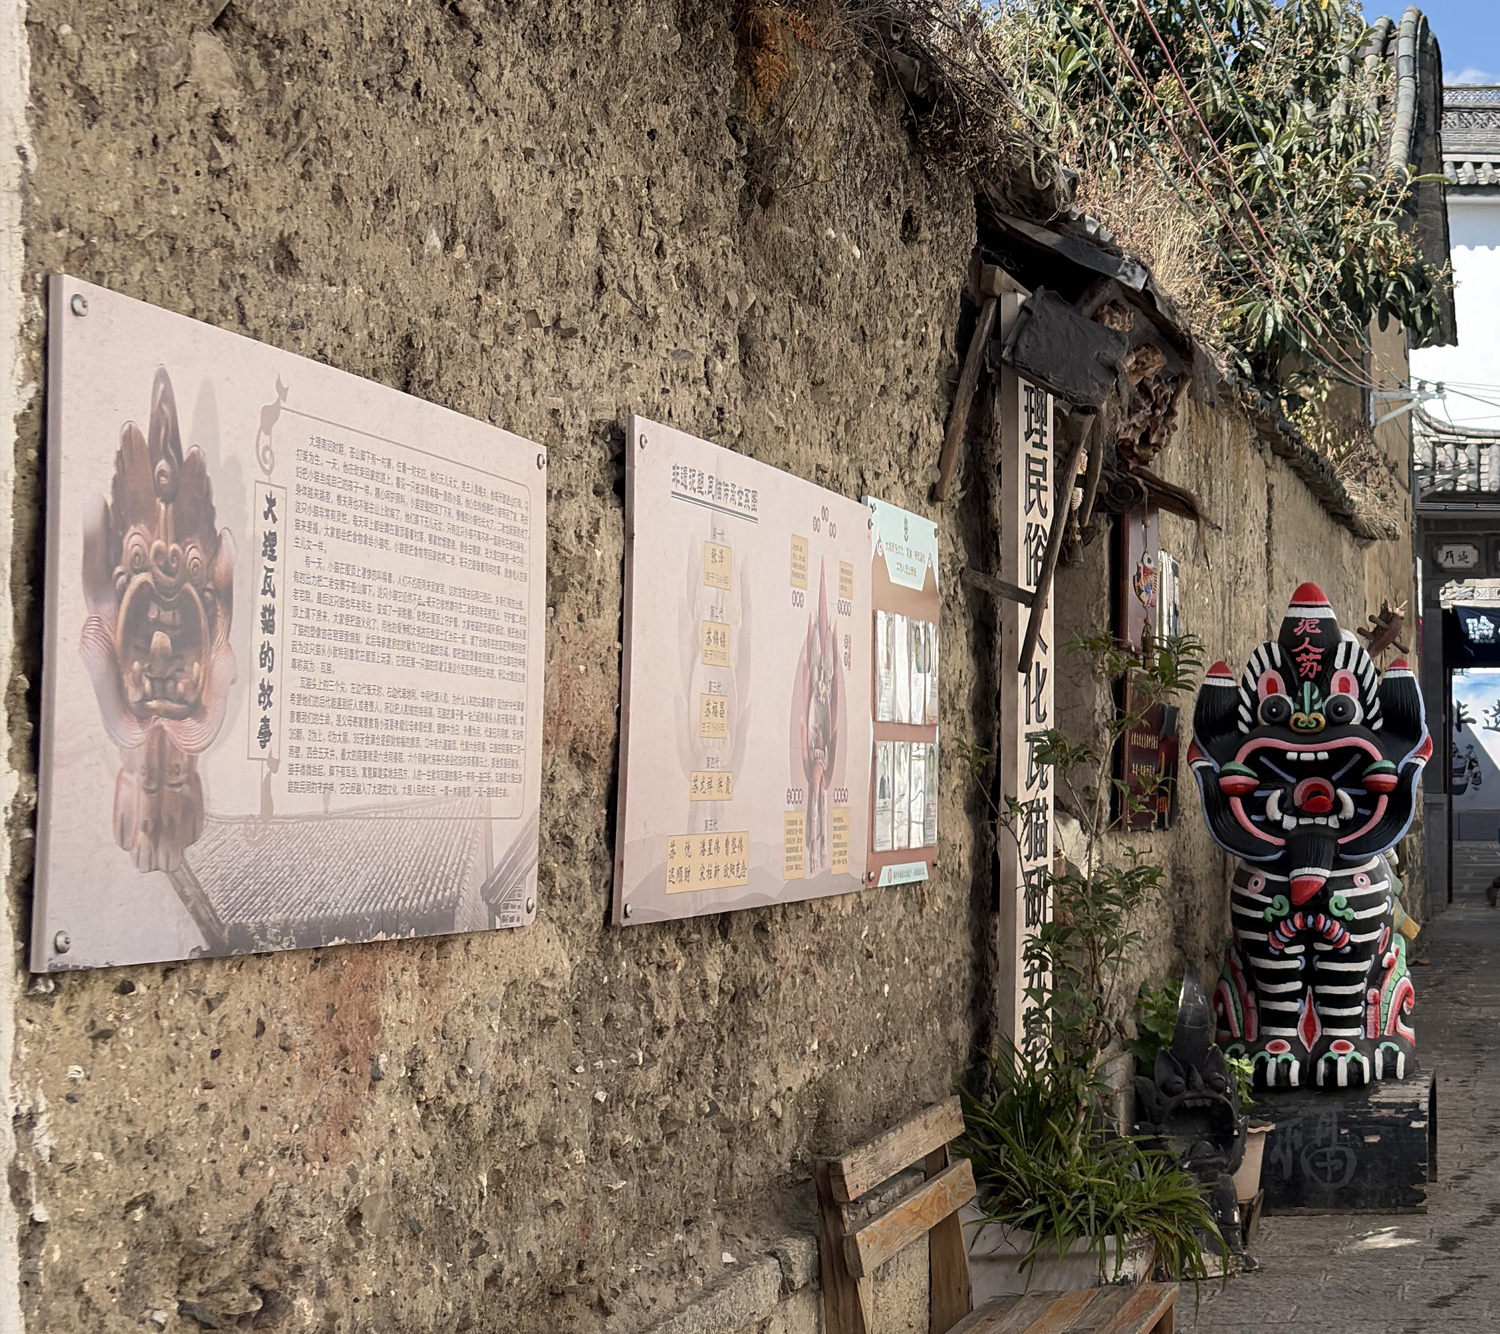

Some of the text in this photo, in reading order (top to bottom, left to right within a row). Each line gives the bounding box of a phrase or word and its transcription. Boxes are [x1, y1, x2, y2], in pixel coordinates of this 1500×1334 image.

[256, 490, 278, 750] 大理瓦猫的故事
[1291, 618, 1325, 679] 泥人苏
